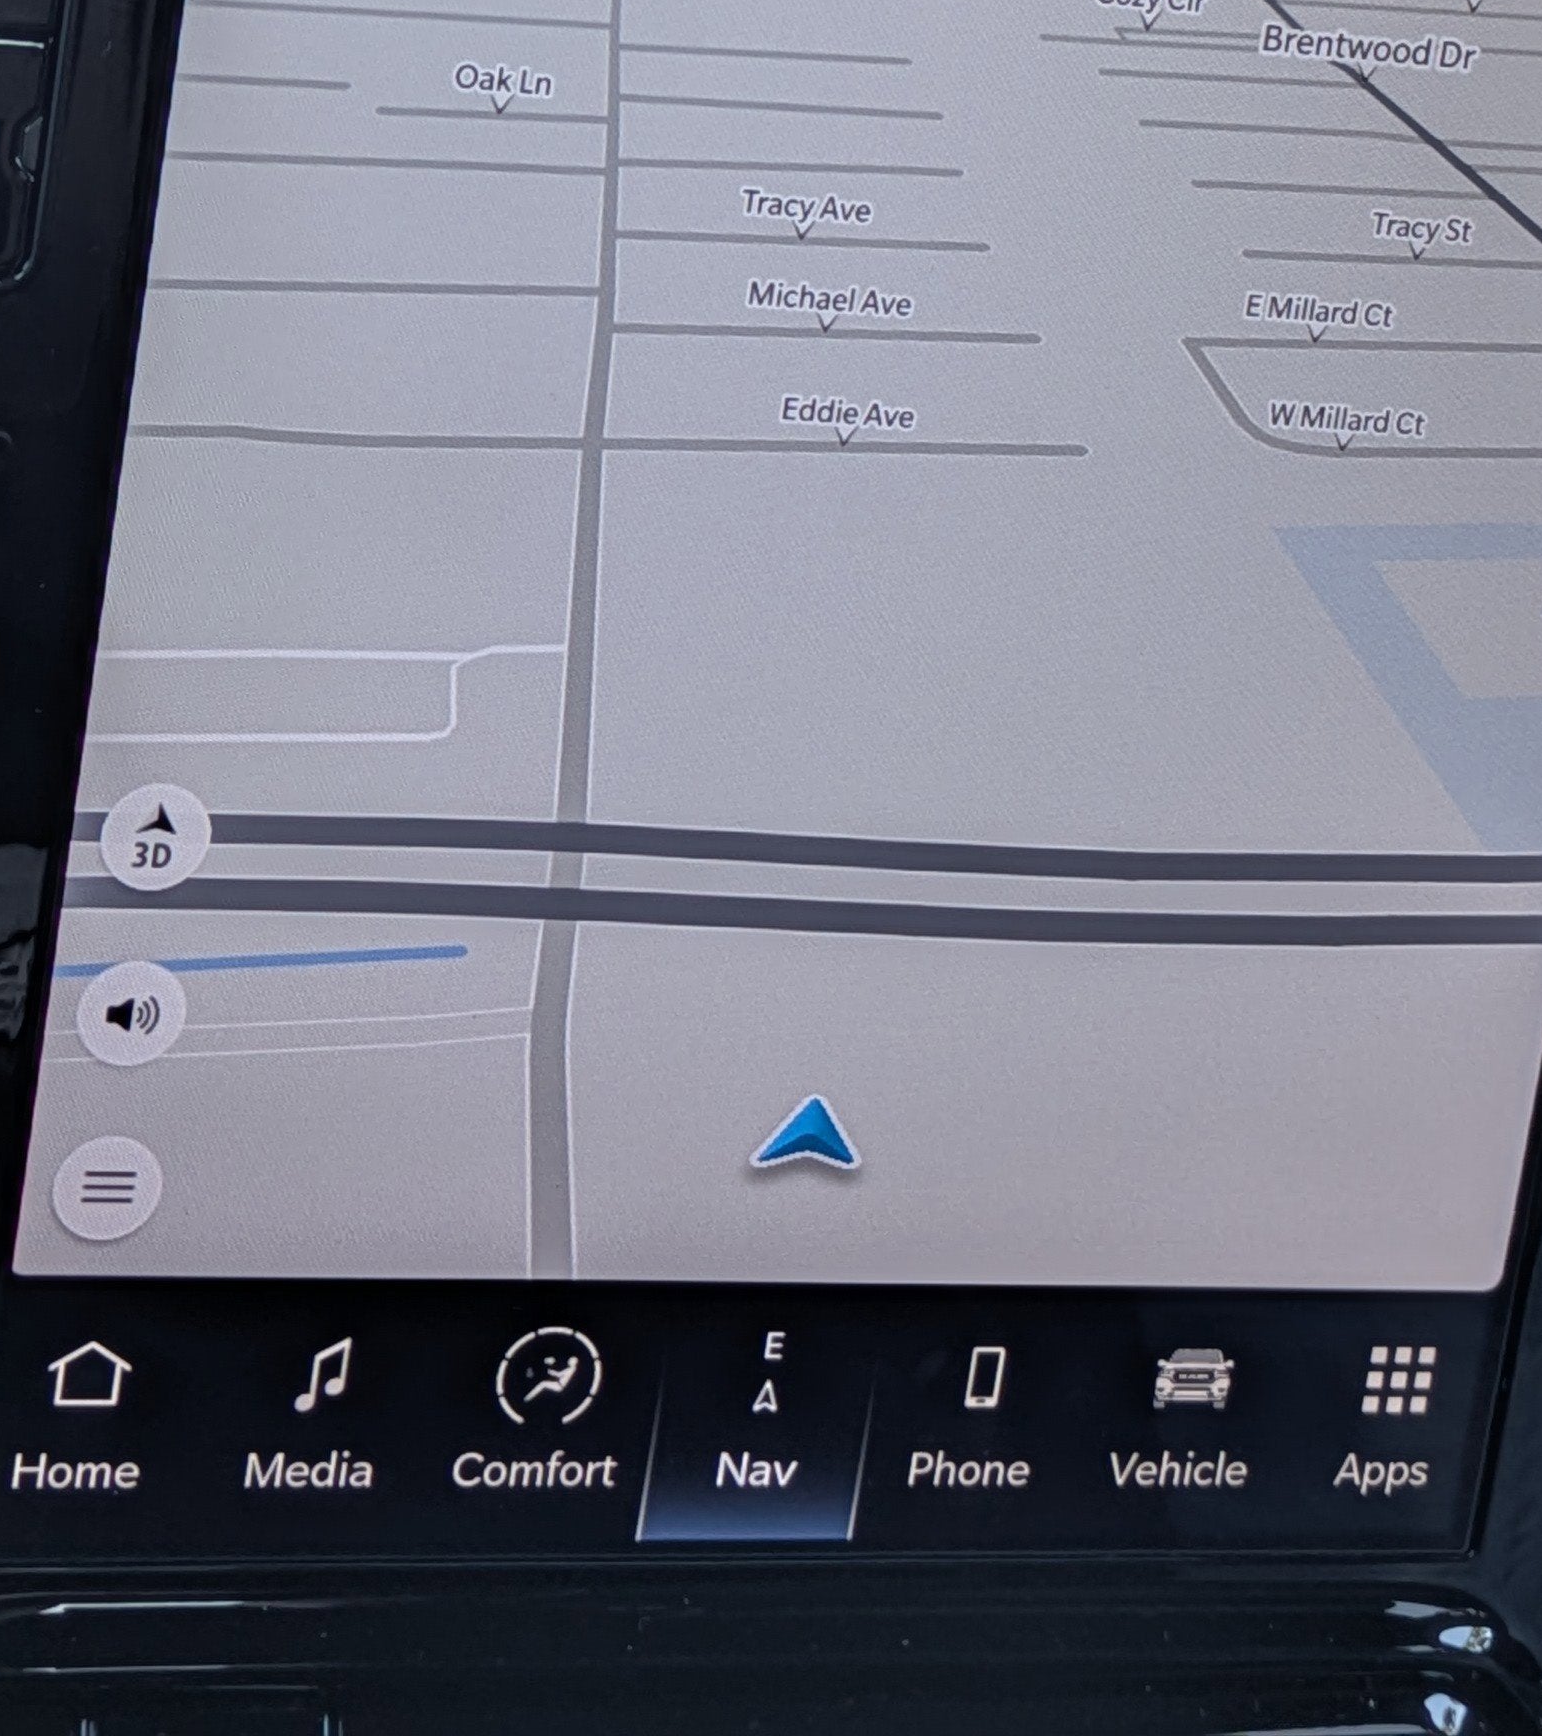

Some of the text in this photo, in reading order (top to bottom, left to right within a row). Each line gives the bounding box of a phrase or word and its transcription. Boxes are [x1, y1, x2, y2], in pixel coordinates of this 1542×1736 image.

[1262, 25, 1479, 70] Brentwood Dr
[455, 64, 552, 96] Oak Ln
[742, 189, 872, 224] Tracy Ave
[1372, 212, 1473, 245] Tracy St
[747, 281, 912, 317] Michael Ave
[1245, 295, 1394, 328] E Millard Ct
[781, 397, 915, 430] Eddie Ave
[1269, 403, 1426, 436] W Millard Ct
[130, 841, 173, 870] 3D
[763, 1331, 785, 1361] E
[10, 1451, 141, 1491] Home
[243, 1451, 374, 1491] Media
[451, 1451, 618, 1491] Comfort
[715, 1451, 800, 1491] Nav
[908, 1450, 1031, 1490] Phone
[1109, 1450, 1249, 1490] Vehicle
[1333, 1452, 1430, 1496] Apps
